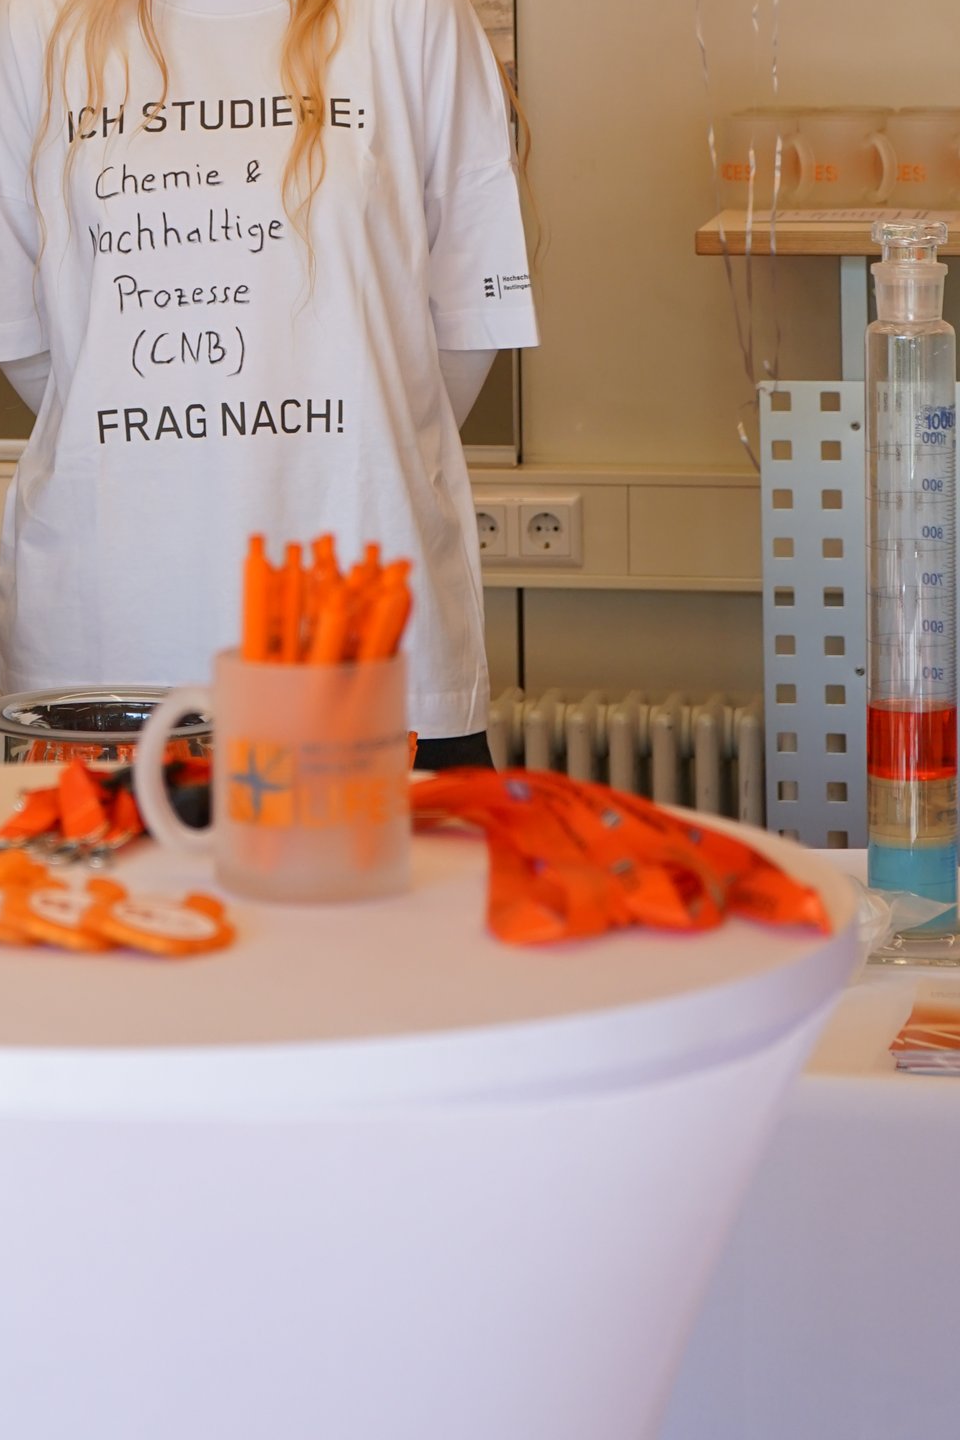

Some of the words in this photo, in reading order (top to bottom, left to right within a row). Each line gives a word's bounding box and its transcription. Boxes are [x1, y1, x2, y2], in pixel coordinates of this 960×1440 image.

[68, 104, 125, 143] ICH
[95, 163, 224, 200] Chemie
[245, 159, 262, 183] &
[88, 208, 286, 259] Nachhaltige
[113, 274, 252, 314] Prozesse
[502, 273, 529, 283] Hochsch
[131, 325, 246, 378] (CNB)
[97, 403, 208, 444] FRAG
[221, 398, 345, 436] NACH!
